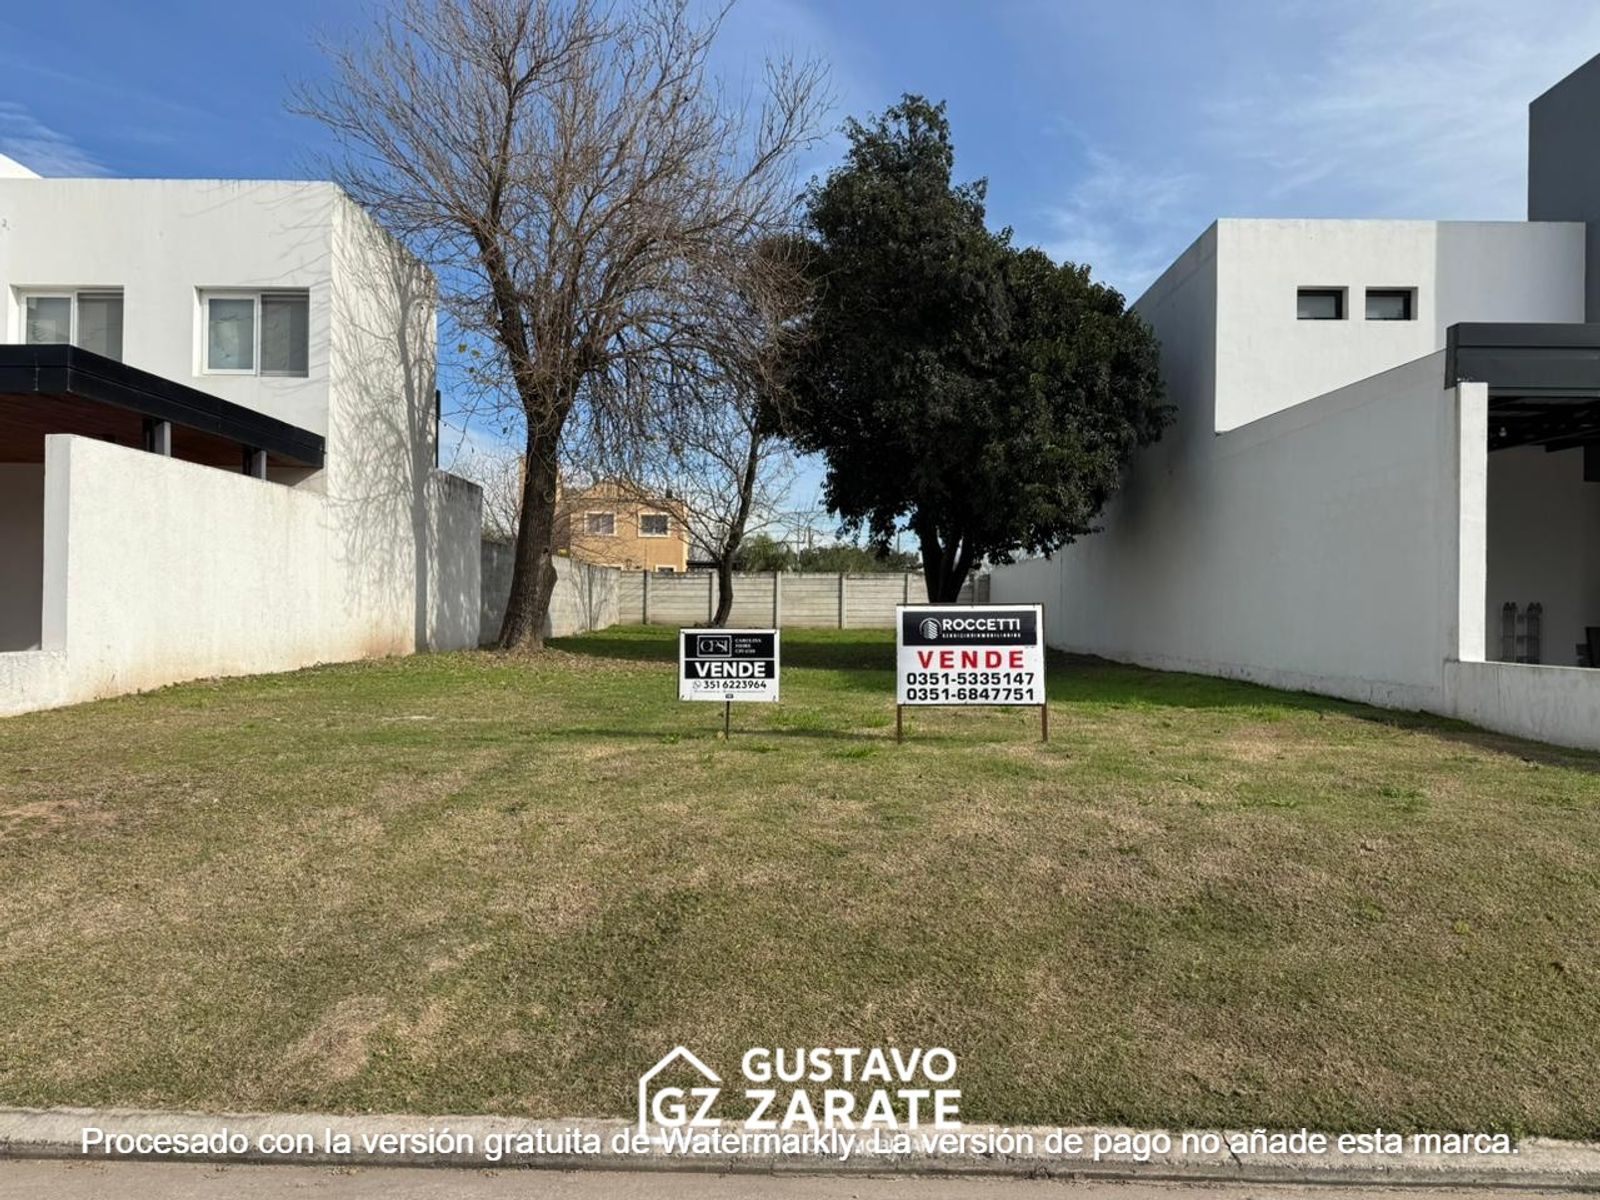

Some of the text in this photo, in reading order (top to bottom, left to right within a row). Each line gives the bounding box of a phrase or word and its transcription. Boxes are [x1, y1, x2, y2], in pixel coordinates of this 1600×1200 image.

[942, 618, 1021, 631] ROCCETTI
[917, 650, 1024, 669] VENDE
[694, 661, 766, 678] VENDE
[703, 680, 767, 689] 351 6223964
[906, 672, 1035, 685] 0351-5335147
[906, 688, 1034, 701] 0351-6847751
